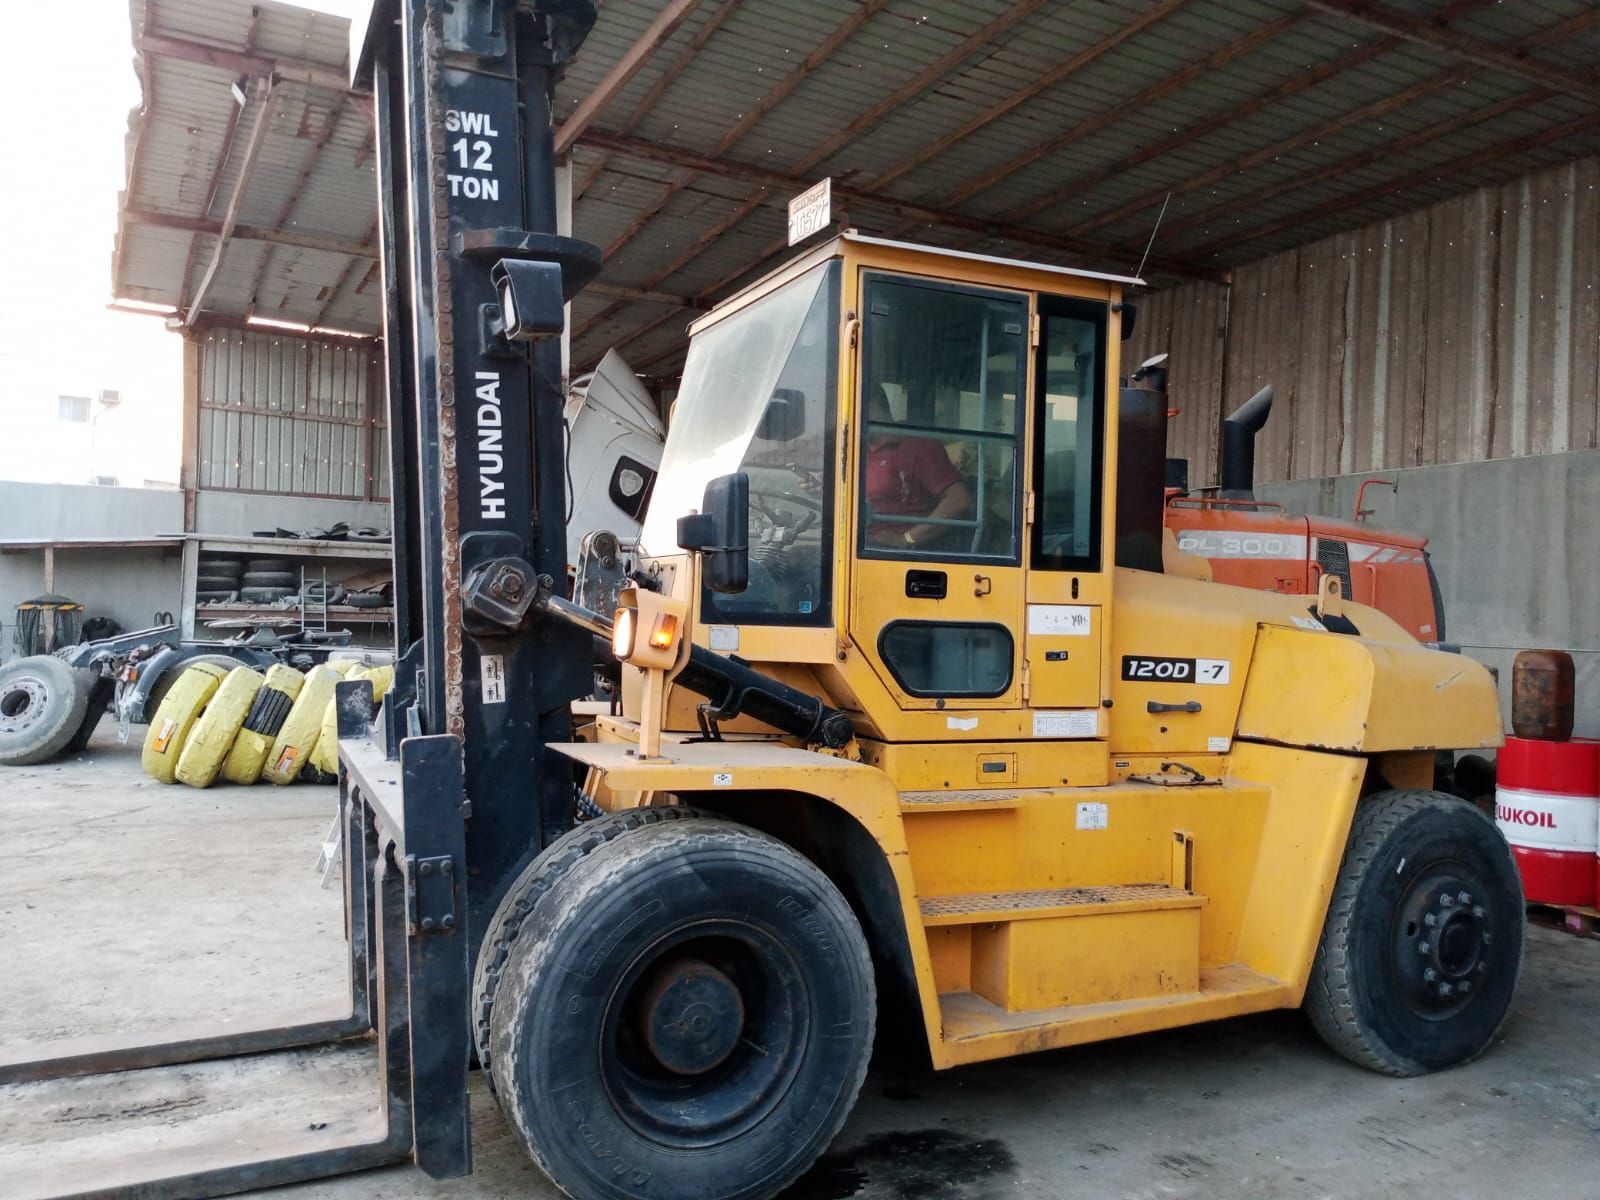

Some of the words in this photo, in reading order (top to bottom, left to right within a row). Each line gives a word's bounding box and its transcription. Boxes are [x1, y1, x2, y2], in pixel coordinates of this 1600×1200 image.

[445, 109, 498, 137] SWL
[453, 138, 493, 171] 12
[447, 174, 499, 201] TON
[475, 371, 506, 519] HYUNDAI
[1498, 804, 1558, 829] LUKOIL
